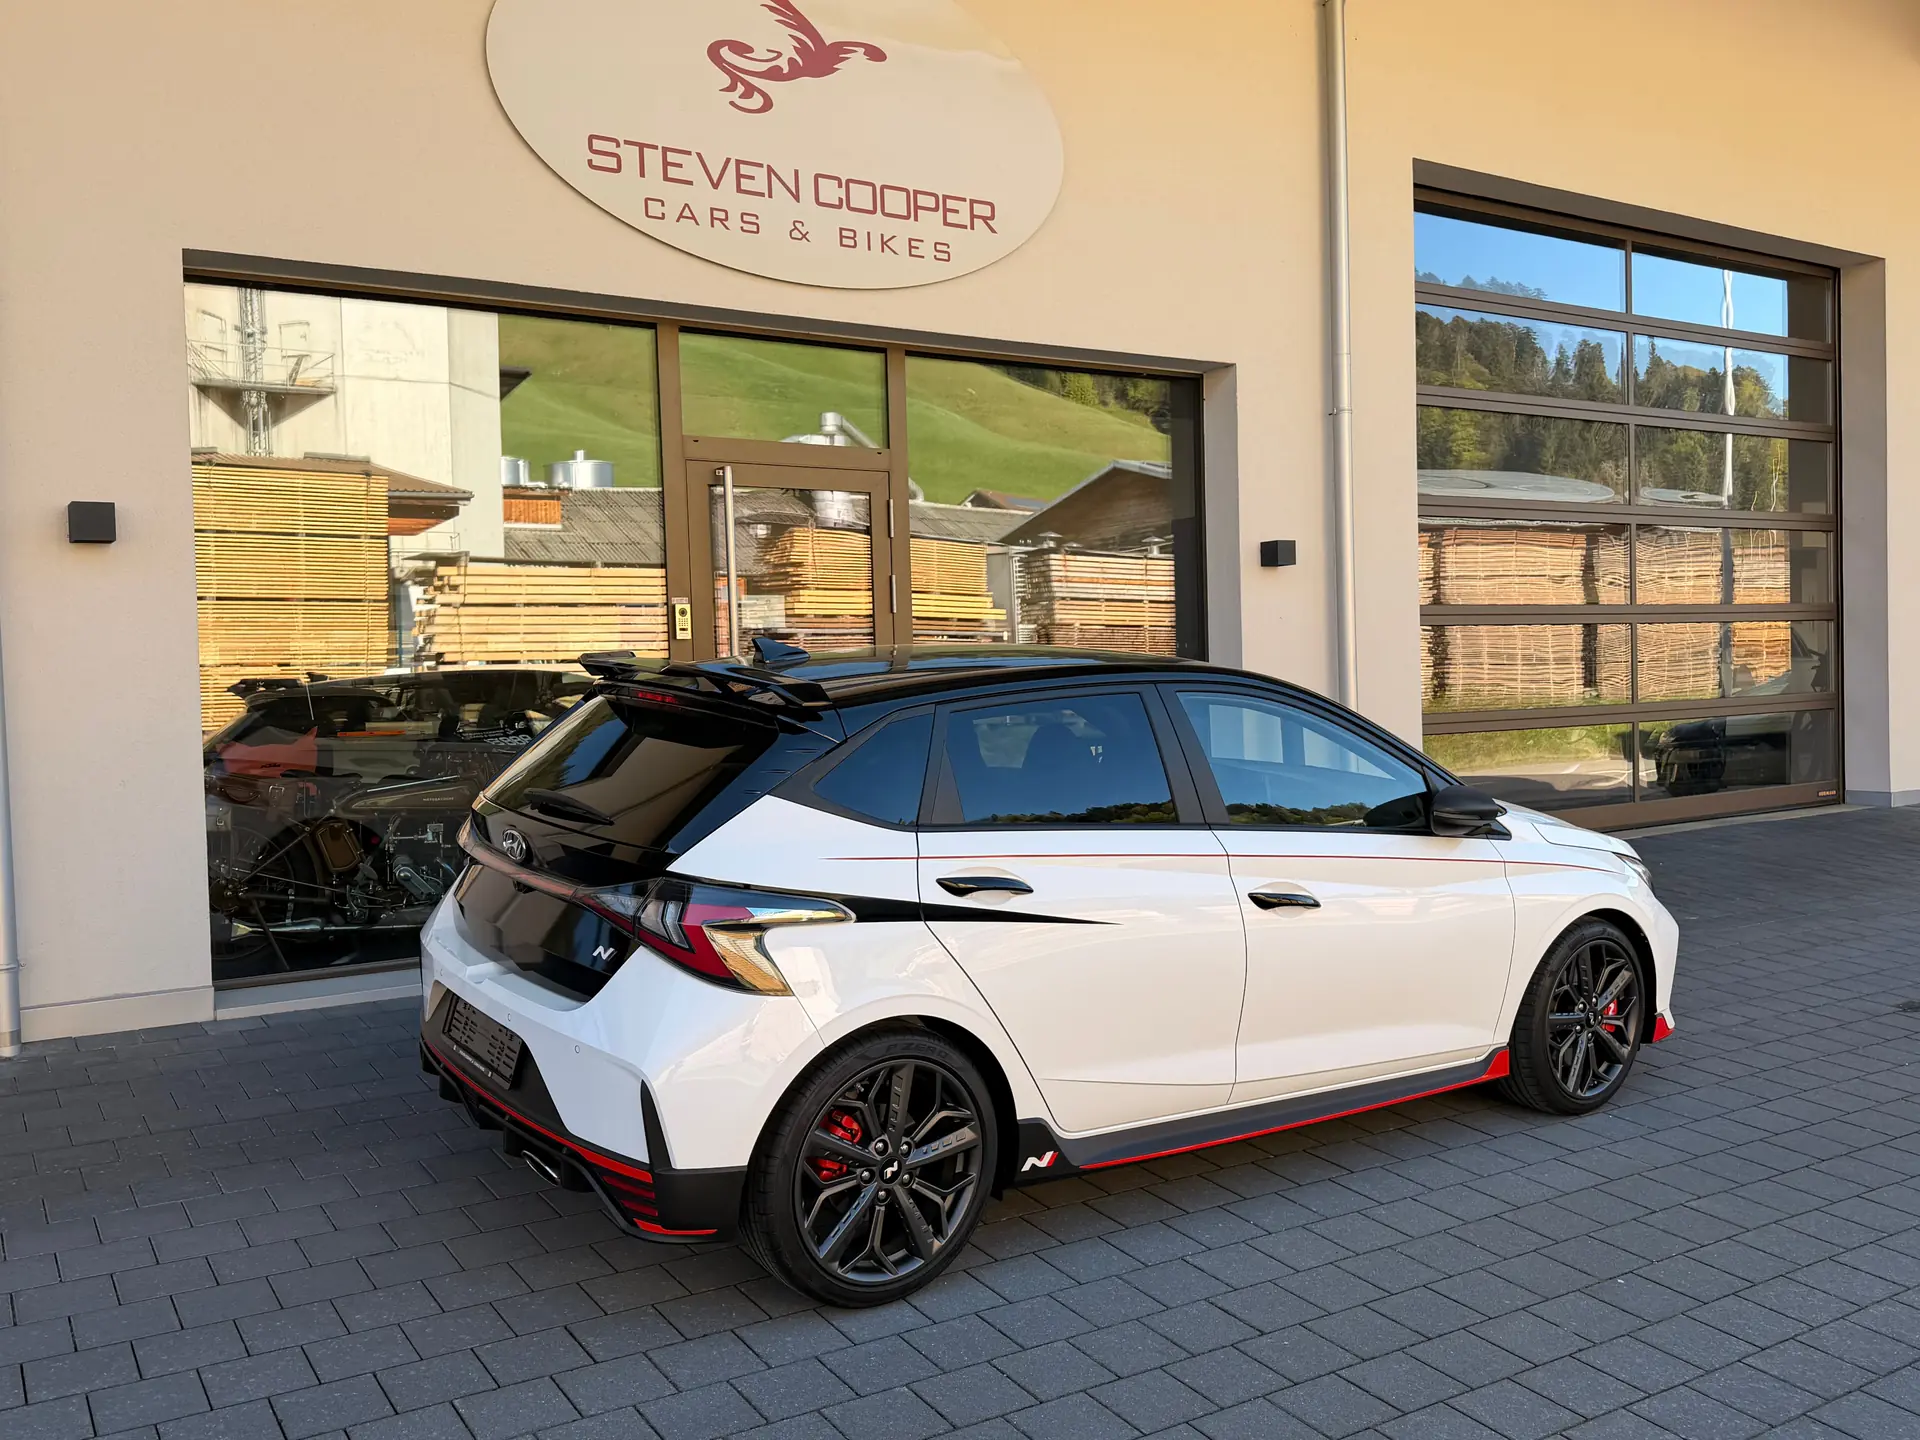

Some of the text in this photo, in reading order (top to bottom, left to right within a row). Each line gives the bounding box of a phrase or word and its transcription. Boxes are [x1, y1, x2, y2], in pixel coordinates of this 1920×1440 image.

[587, 133, 998, 234] STEVEN COOPER
[643, 196, 952, 263] CARS & BIKES
